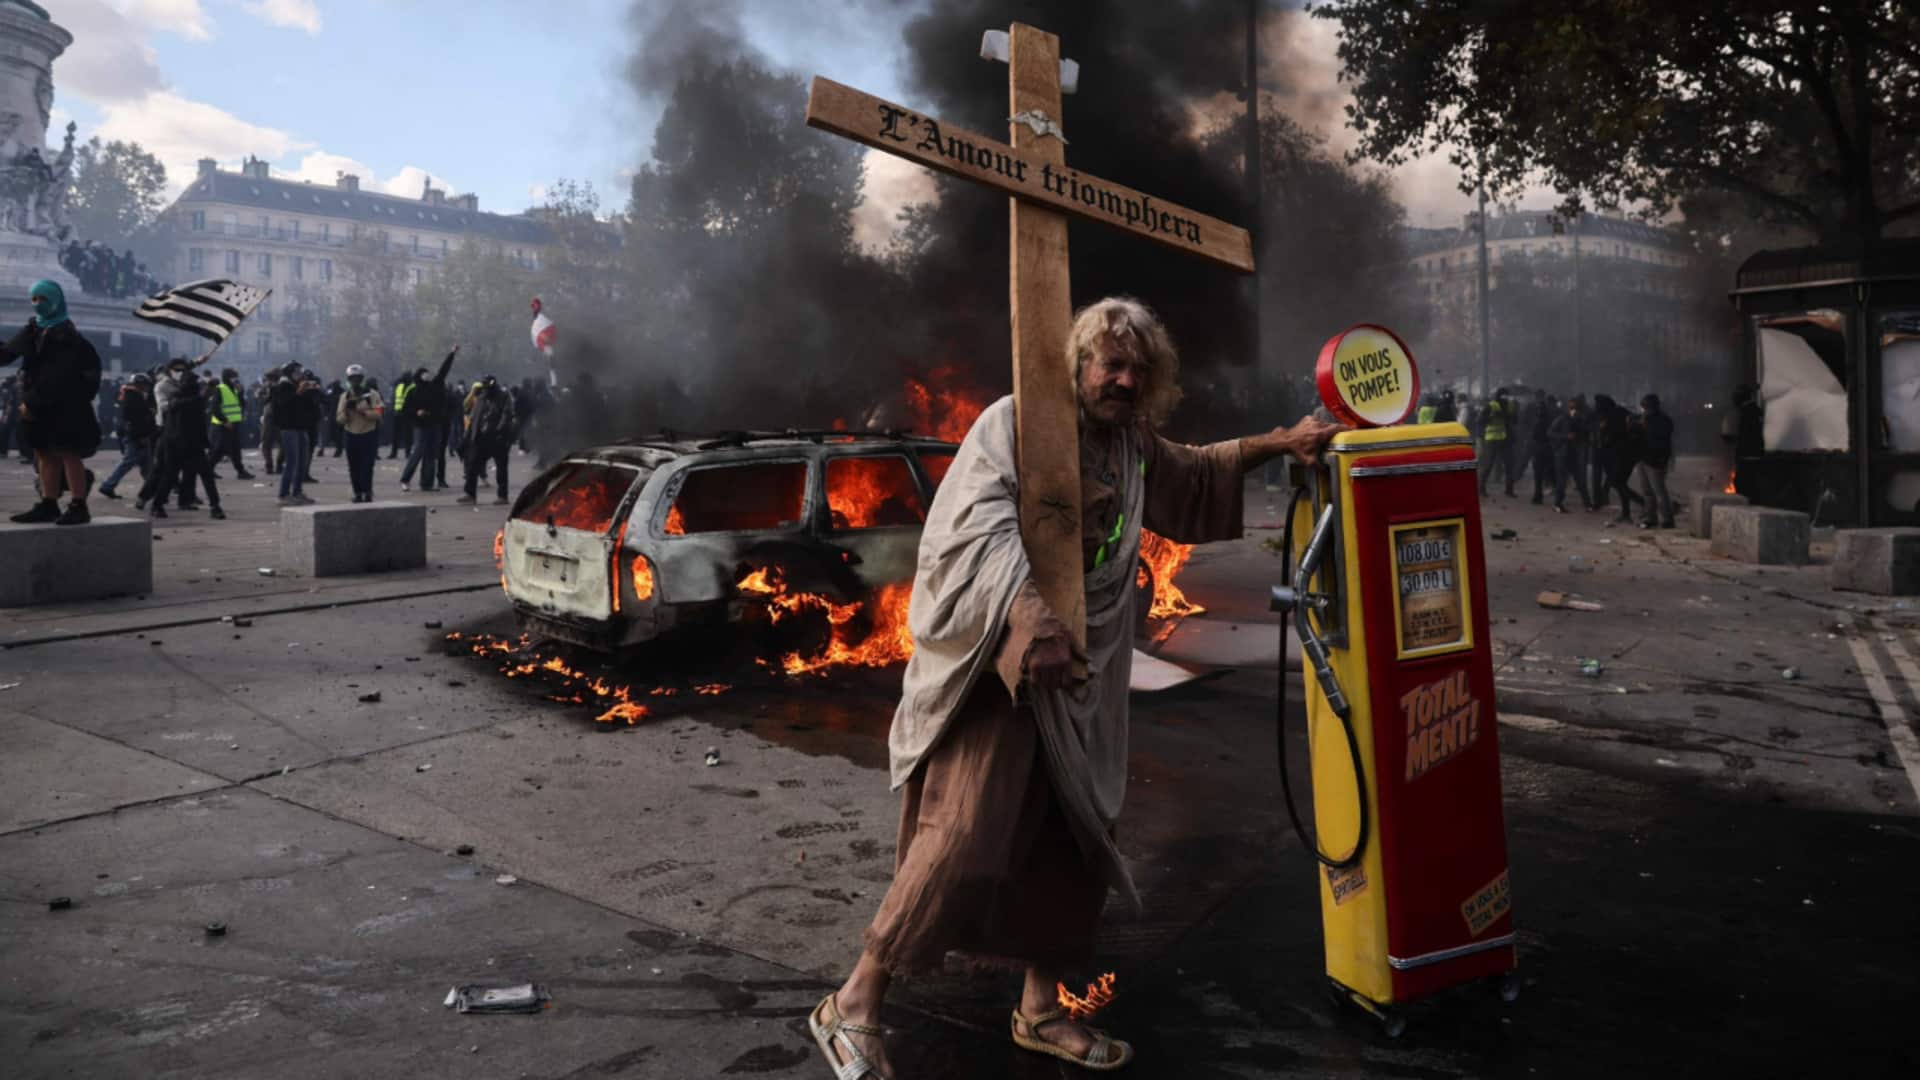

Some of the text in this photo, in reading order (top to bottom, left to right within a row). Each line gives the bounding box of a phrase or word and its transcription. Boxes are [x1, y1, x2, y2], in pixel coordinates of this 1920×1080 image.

[878, 104, 1203, 245] L'Amour triomphera
[1340, 348, 1392, 381] ON VOUS
[1349, 368, 1401, 406] POMPE!
[1400, 669, 1471, 738] TOTAL
[1405, 699, 1481, 784] MENT!
